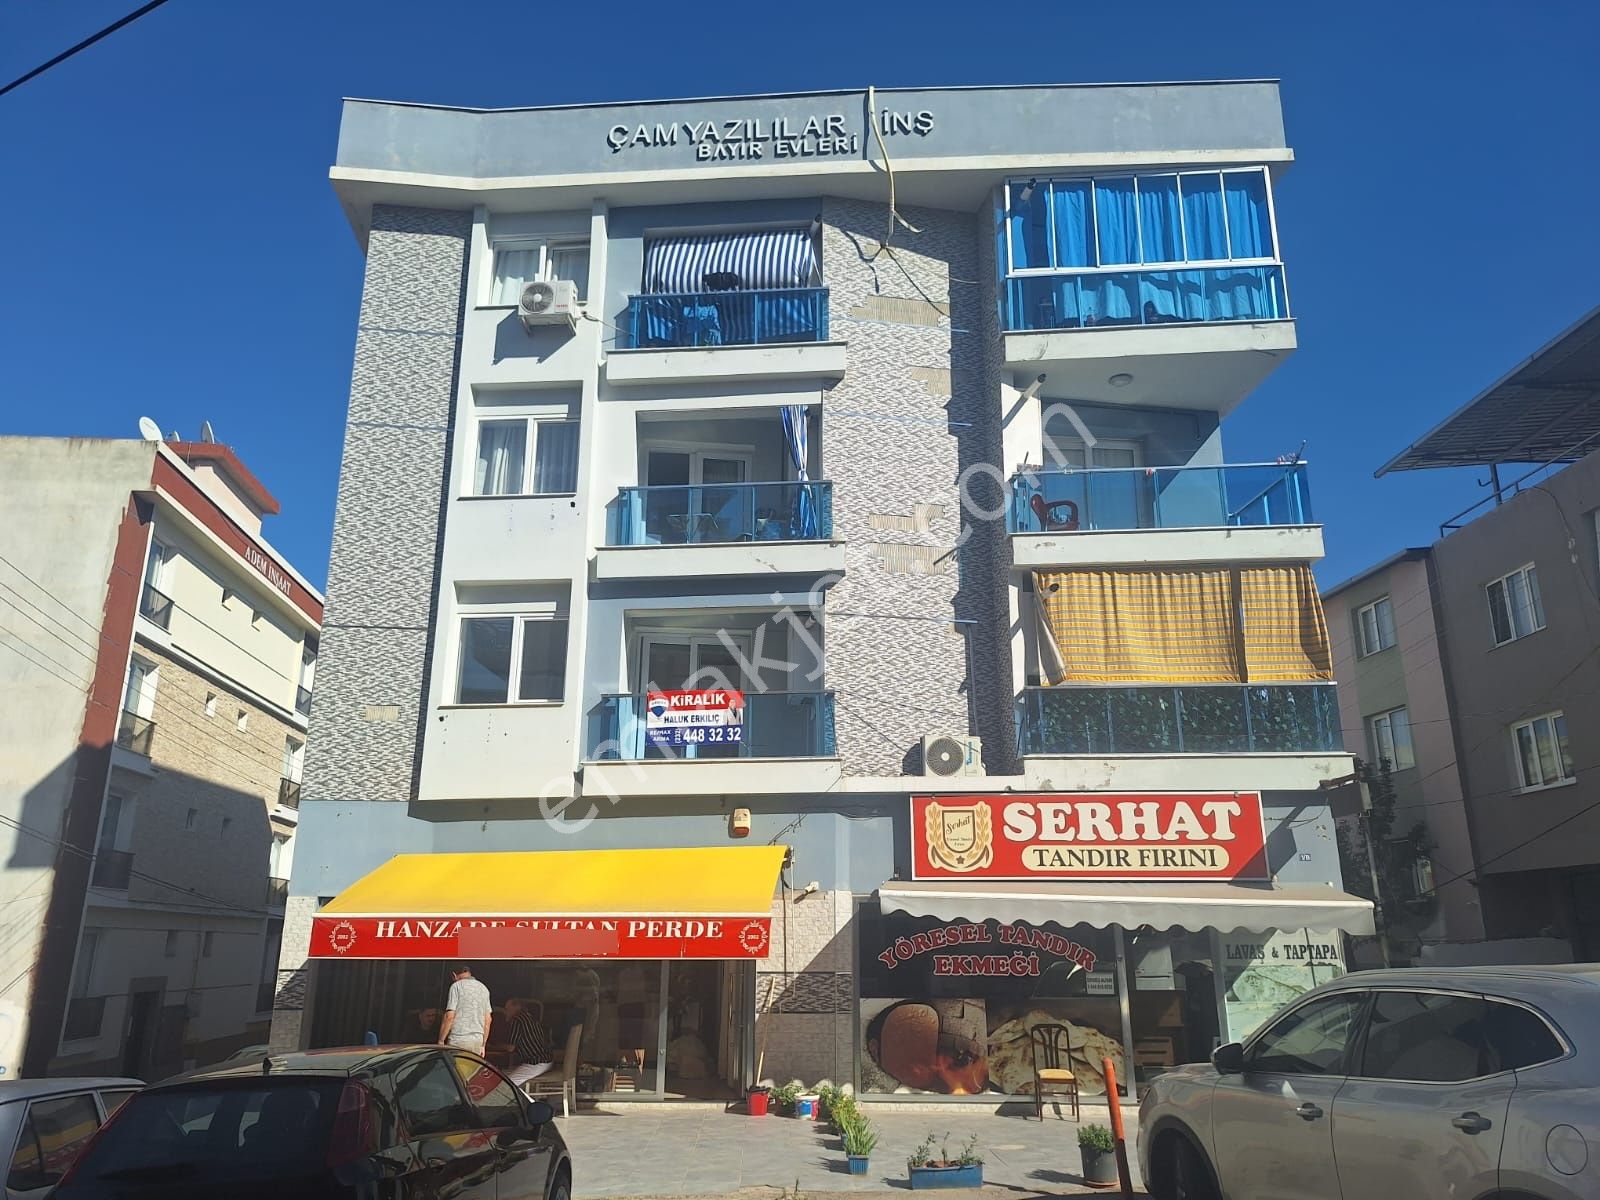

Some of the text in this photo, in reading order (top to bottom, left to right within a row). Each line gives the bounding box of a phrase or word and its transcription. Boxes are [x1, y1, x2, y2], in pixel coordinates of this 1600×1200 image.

[882, 107, 935, 135] İNŞ
[698, 132, 858, 160] BAYIR EVLERİ
[664, 715, 689, 724] HALUK
[683, 729, 705, 743] 448
[709, 728, 723, 742] 32
[727, 727, 741, 741] 32
[945, 815, 971, 835] Serhat
[1003, 801, 1242, 842] SERHAT
[1033, 848, 1218, 868] TANDIR FIRINI
[627, 920, 723, 938] PERDE
[879, 924, 1096, 972] YÖRESEL TANDIR
[1225, 944, 1338, 964] LAVAŞ & TAPTAPA
[933, 951, 1040, 976] EKMEĞİ
